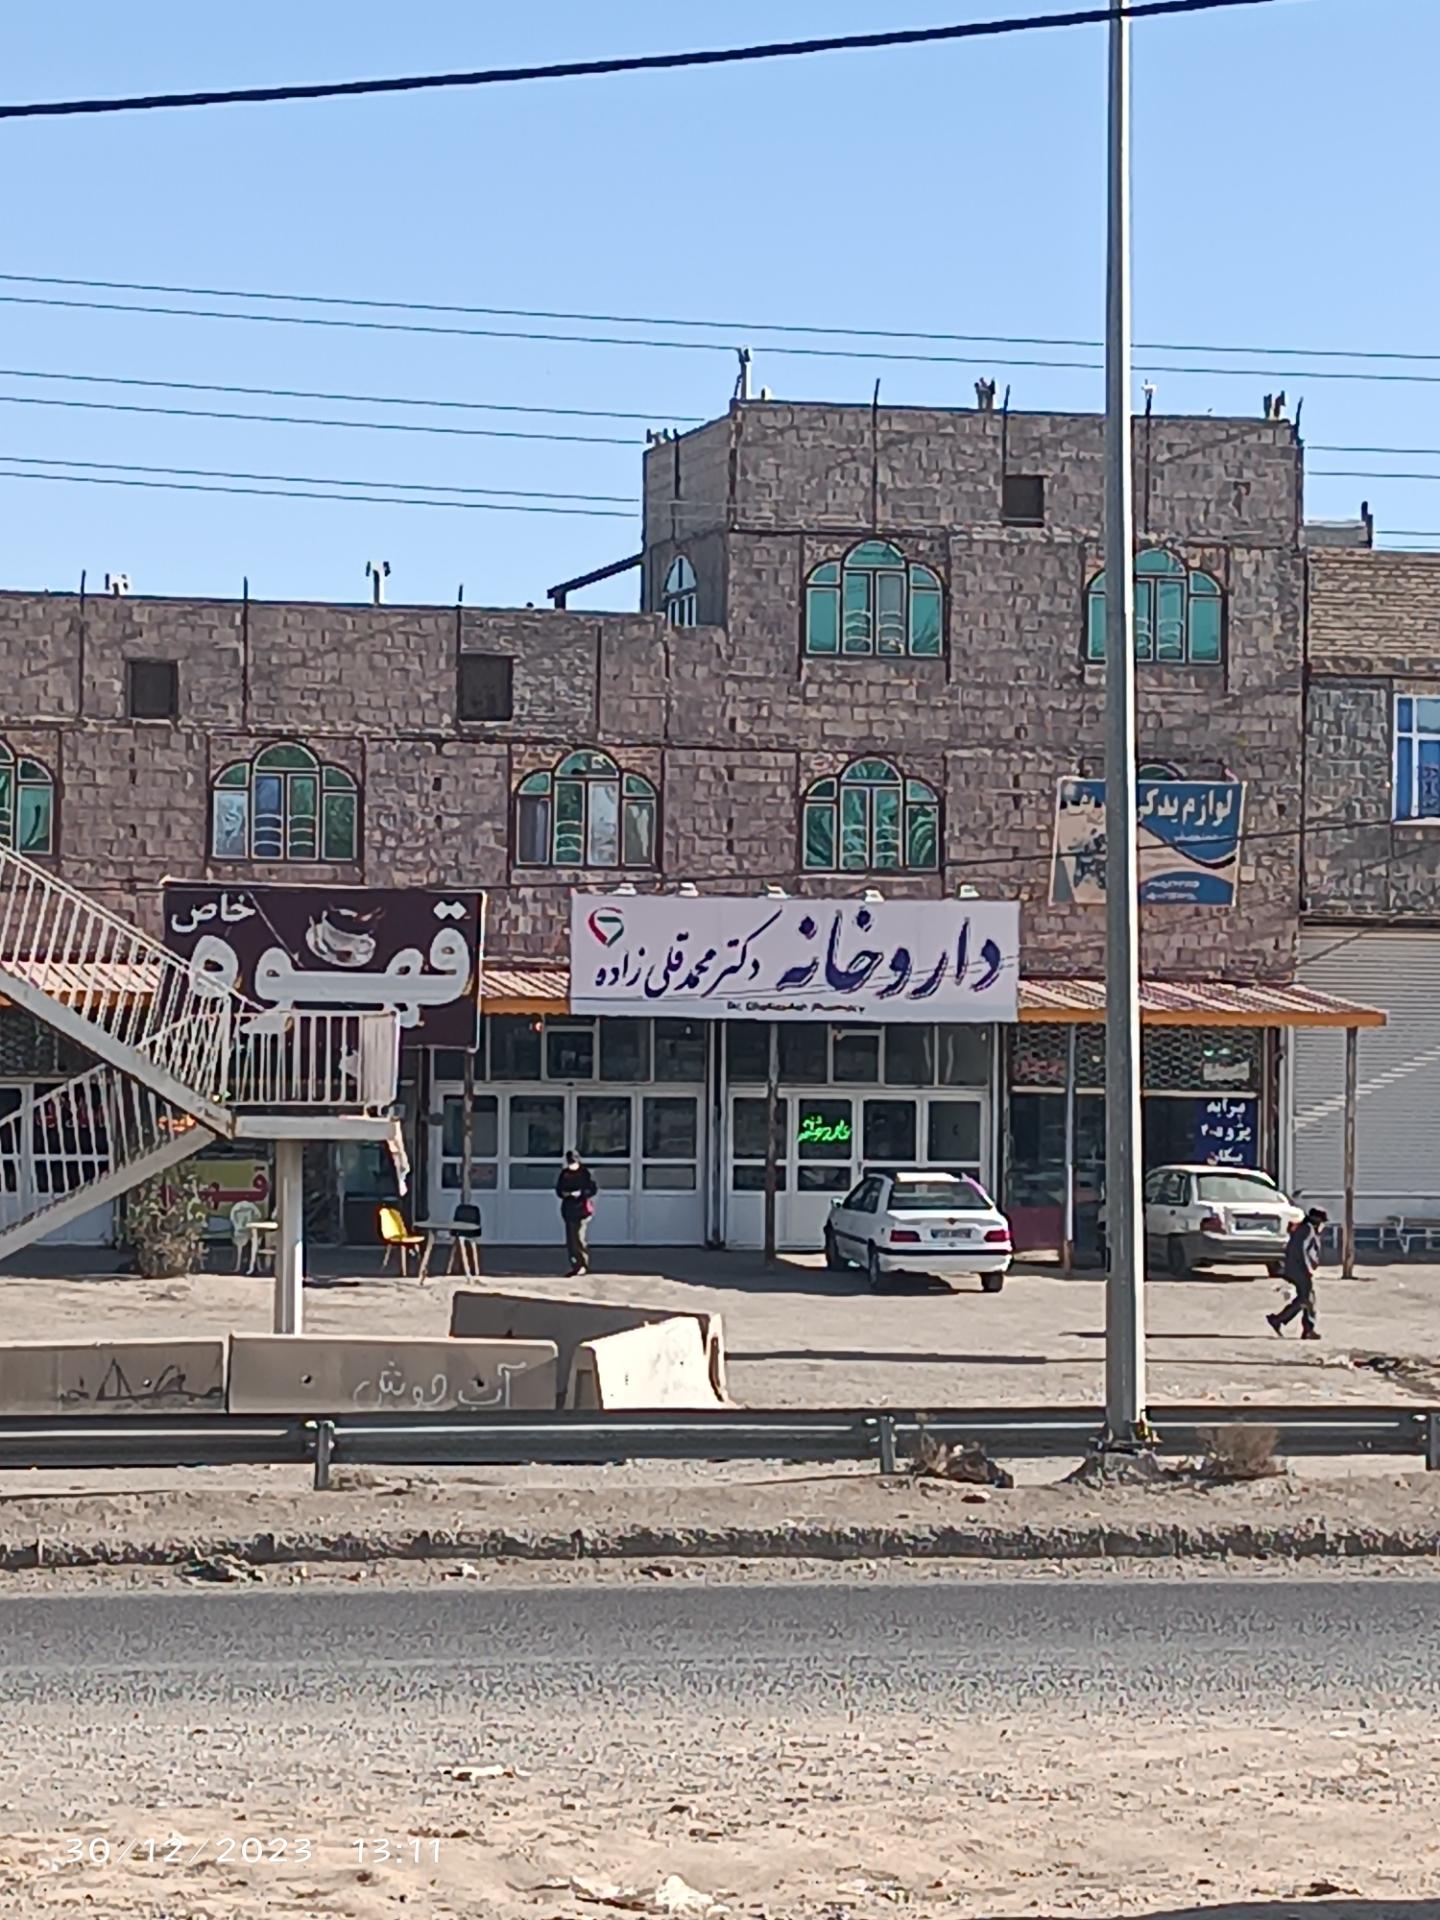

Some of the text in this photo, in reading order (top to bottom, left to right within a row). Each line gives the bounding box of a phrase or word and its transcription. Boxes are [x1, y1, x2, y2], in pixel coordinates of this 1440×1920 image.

[1182, 788, 1233, 827] لوازم
[171, 893, 256, 933] خاص
[188, 900, 471, 1034] قهوه
[594, 904, 1001, 1000] داروخانه دکتر محمد قلی زاده
[458, 1361, 527, 1411] آب
